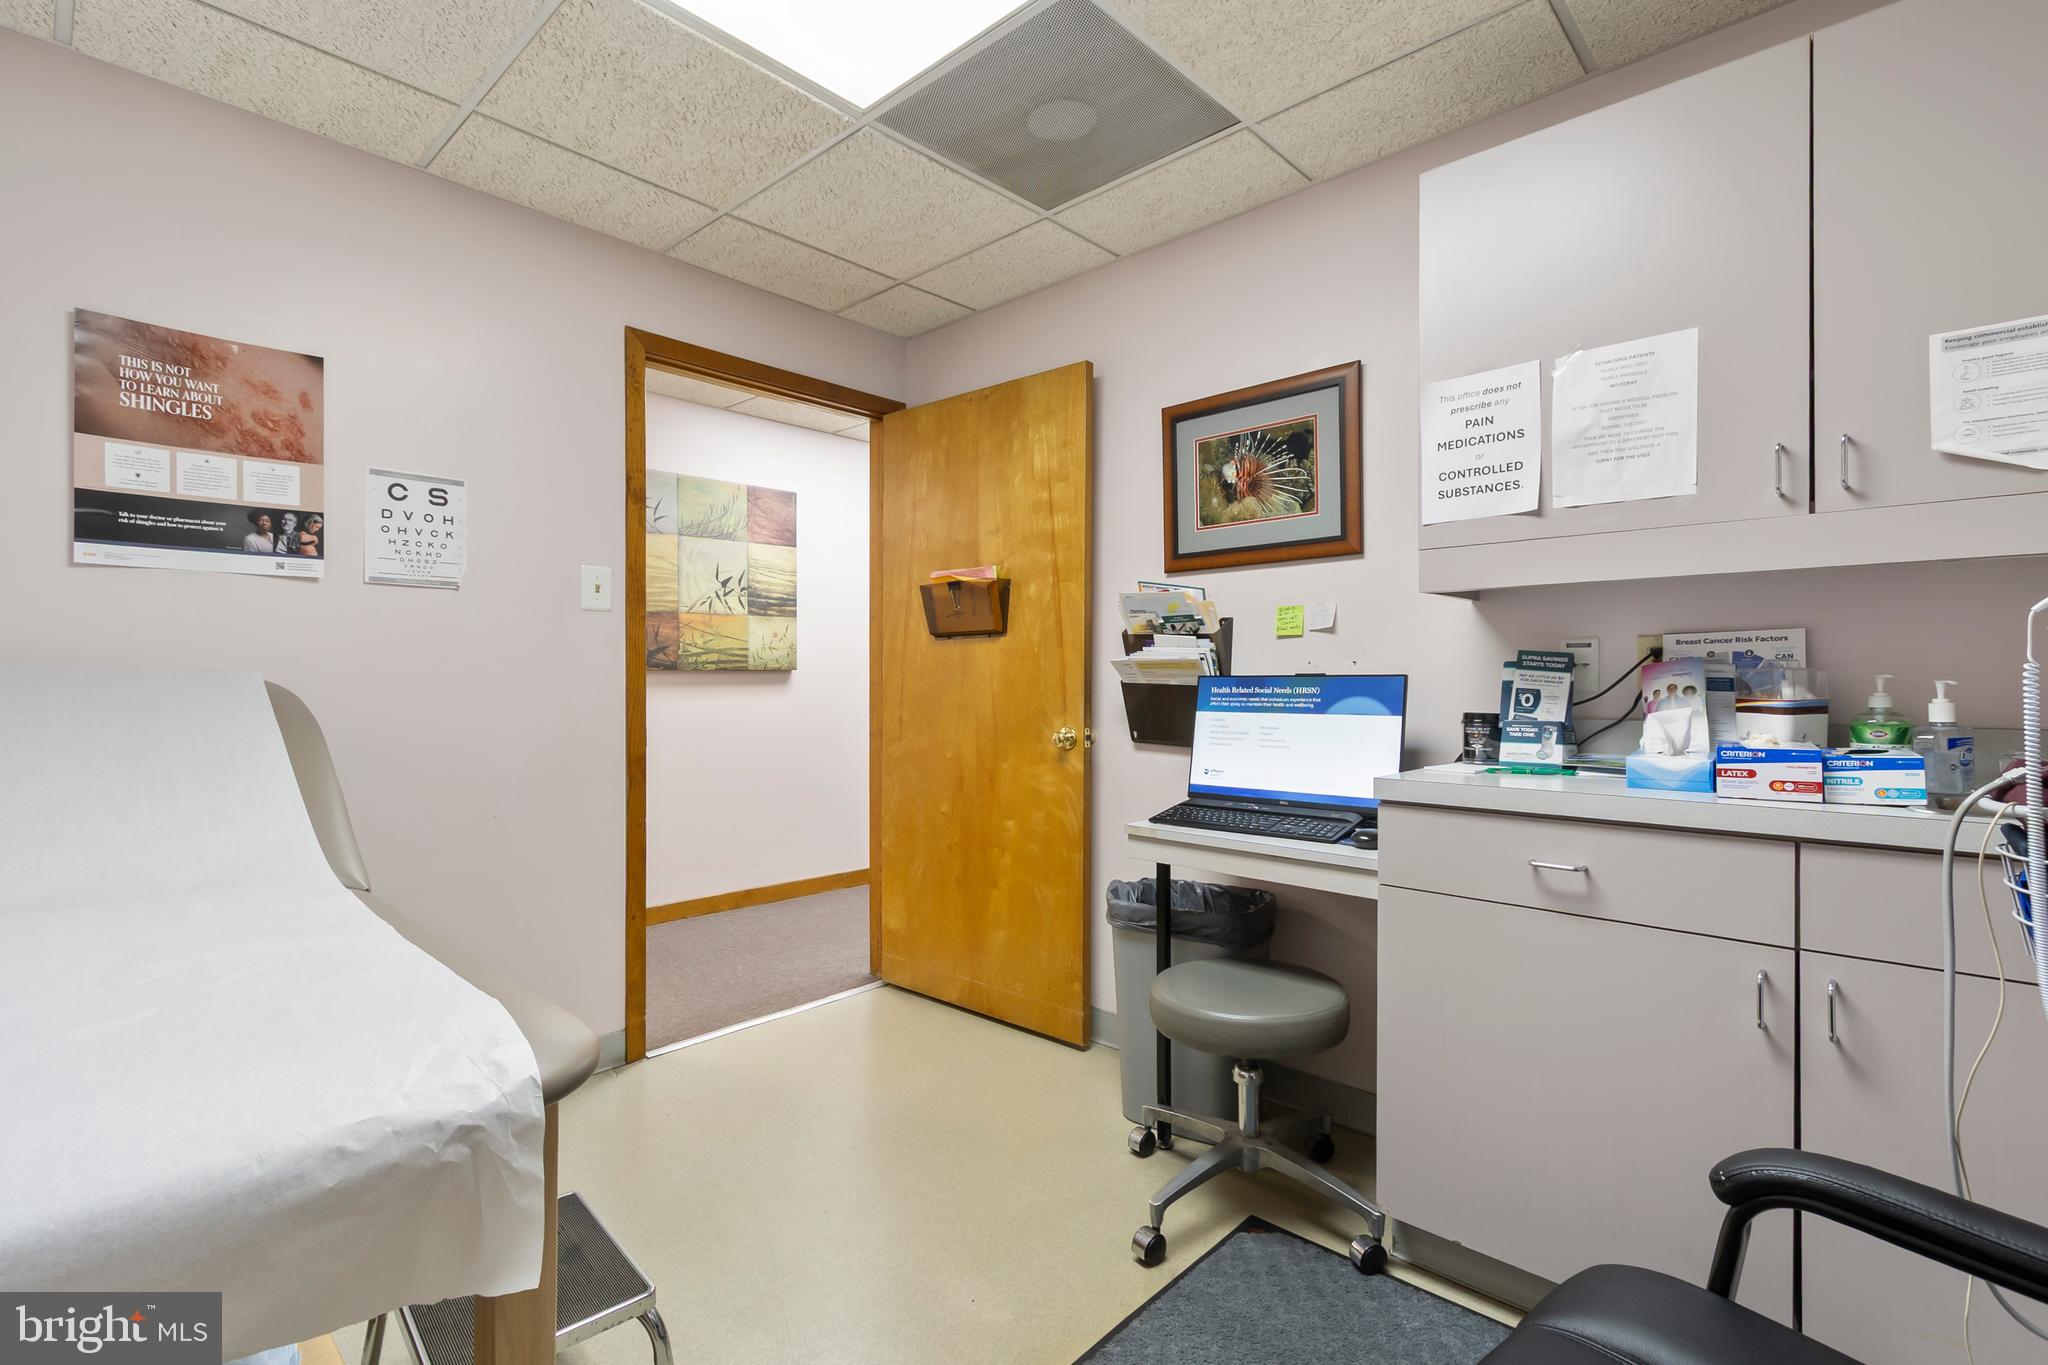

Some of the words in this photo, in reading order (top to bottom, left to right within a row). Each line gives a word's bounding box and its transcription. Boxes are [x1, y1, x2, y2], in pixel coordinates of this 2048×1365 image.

[119, 355, 148, 369] THIS
[152, 361, 162, 372] IS
[166, 364, 191, 377] NOT
[119, 367, 152, 381] HOW
[155, 373, 181, 387] YOU
[184, 379, 220, 393] WANT
[119, 379, 137, 391] TO
[140, 382, 179, 398] LEARN
[182, 391, 224, 405] ABOUT
[1440, 396, 1455, 404] This
[1458, 391, 1481, 400] office
[1482, 387, 1504, 395] does
[1506, 381, 1522, 391] not
[119, 391, 212, 420] SHINGLES
[1450, 400, 1492, 415] prescribe
[1494, 397, 1510, 407] any
[1465, 415, 1494, 429] PAIN
[1437, 428, 1525, 452] MEDICATIONS
[1475, 453, 1484, 461] or
[1439, 461, 1524, 481] CONTROLLED
[388, 483, 408, 501] C
[429, 488, 448, 506] S
[1438, 480, 1524, 500] SUBSTANCES.
[382, 509, 393, 519] D
[403, 511, 413, 520] V
[424, 514, 434, 522] O
[443, 515, 453, 525] H
[381, 525, 390, 533] O
[398, 527, 407, 535] H
[415, 528, 422, 536] V
[446, 531, 454, 539] K
[1293, 686, 1320, 694] (HRSN)
